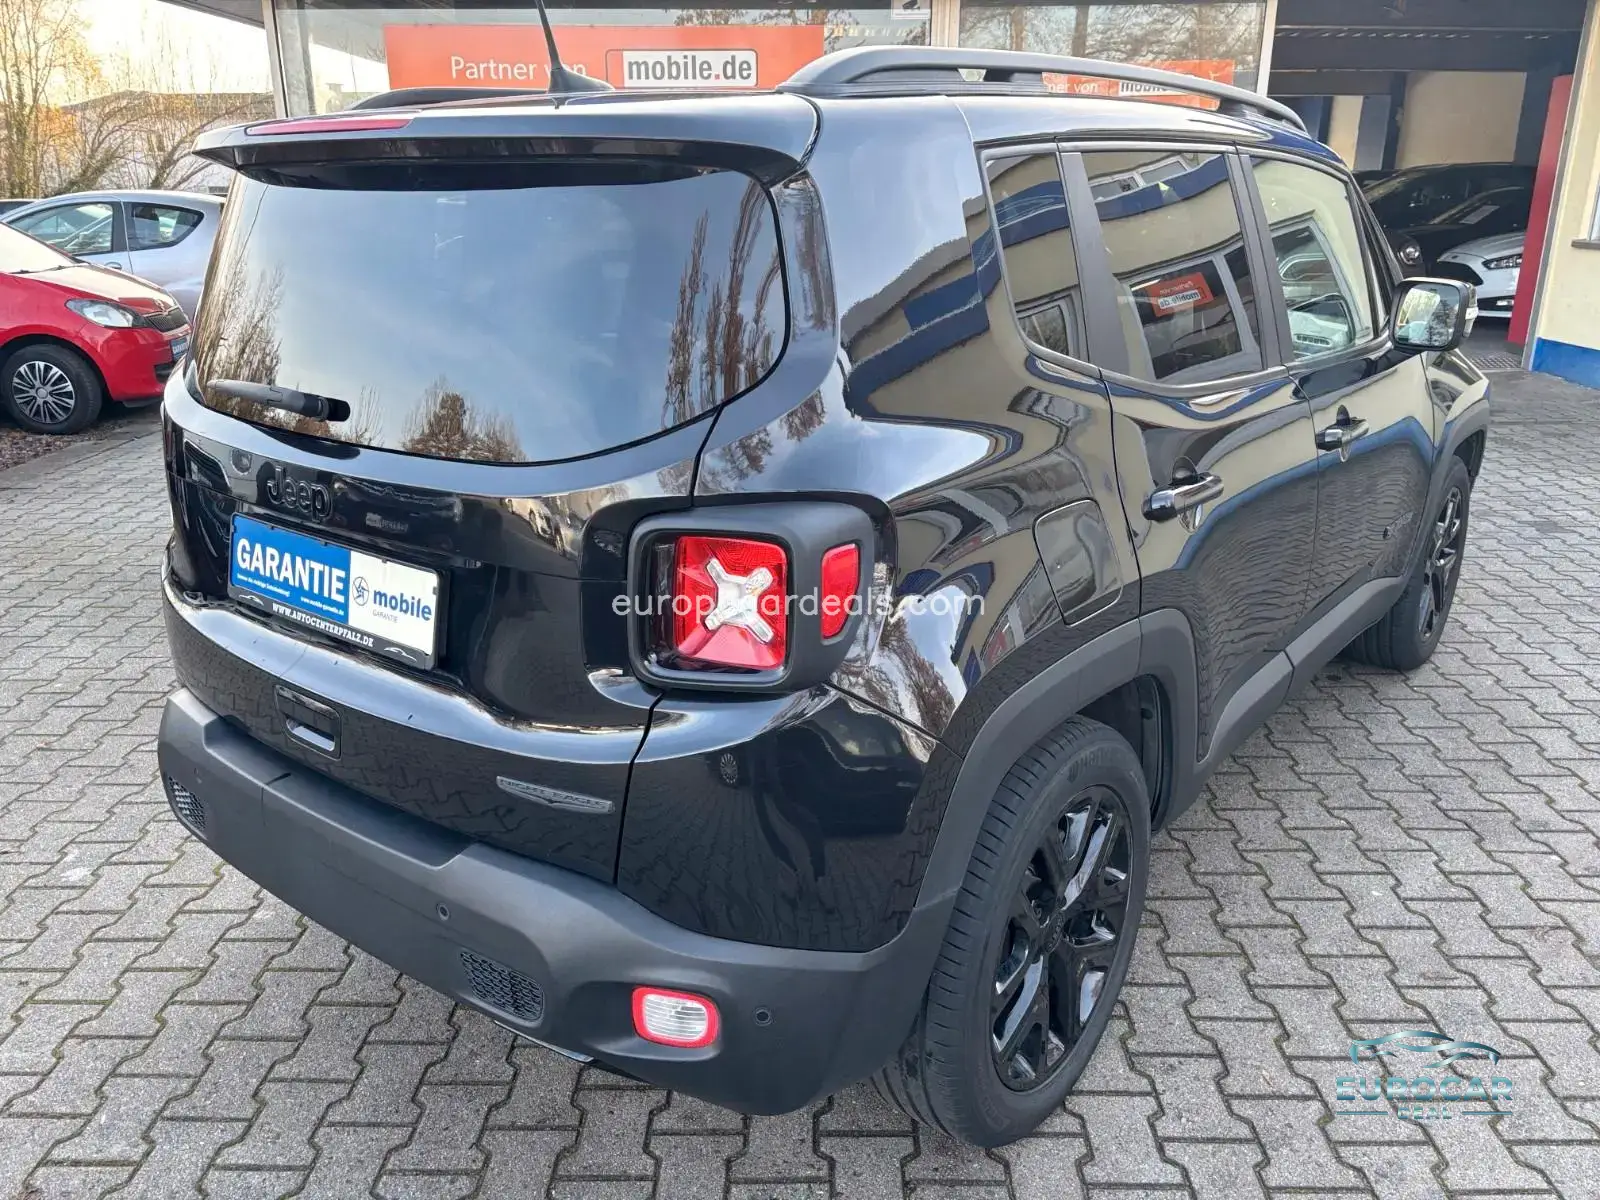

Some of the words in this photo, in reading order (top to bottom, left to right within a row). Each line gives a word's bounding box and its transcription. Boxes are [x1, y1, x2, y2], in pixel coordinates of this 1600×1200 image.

[451, 55, 537, 80] Partner
[627, 54, 752, 81] mobile.de
[266, 465, 332, 522] Jeep
[237, 538, 346, 603] GARANTIE
[373, 589, 432, 621] mobile
[272, 602, 374, 648] WWW.AUTOCENTERPFALZ.DE
